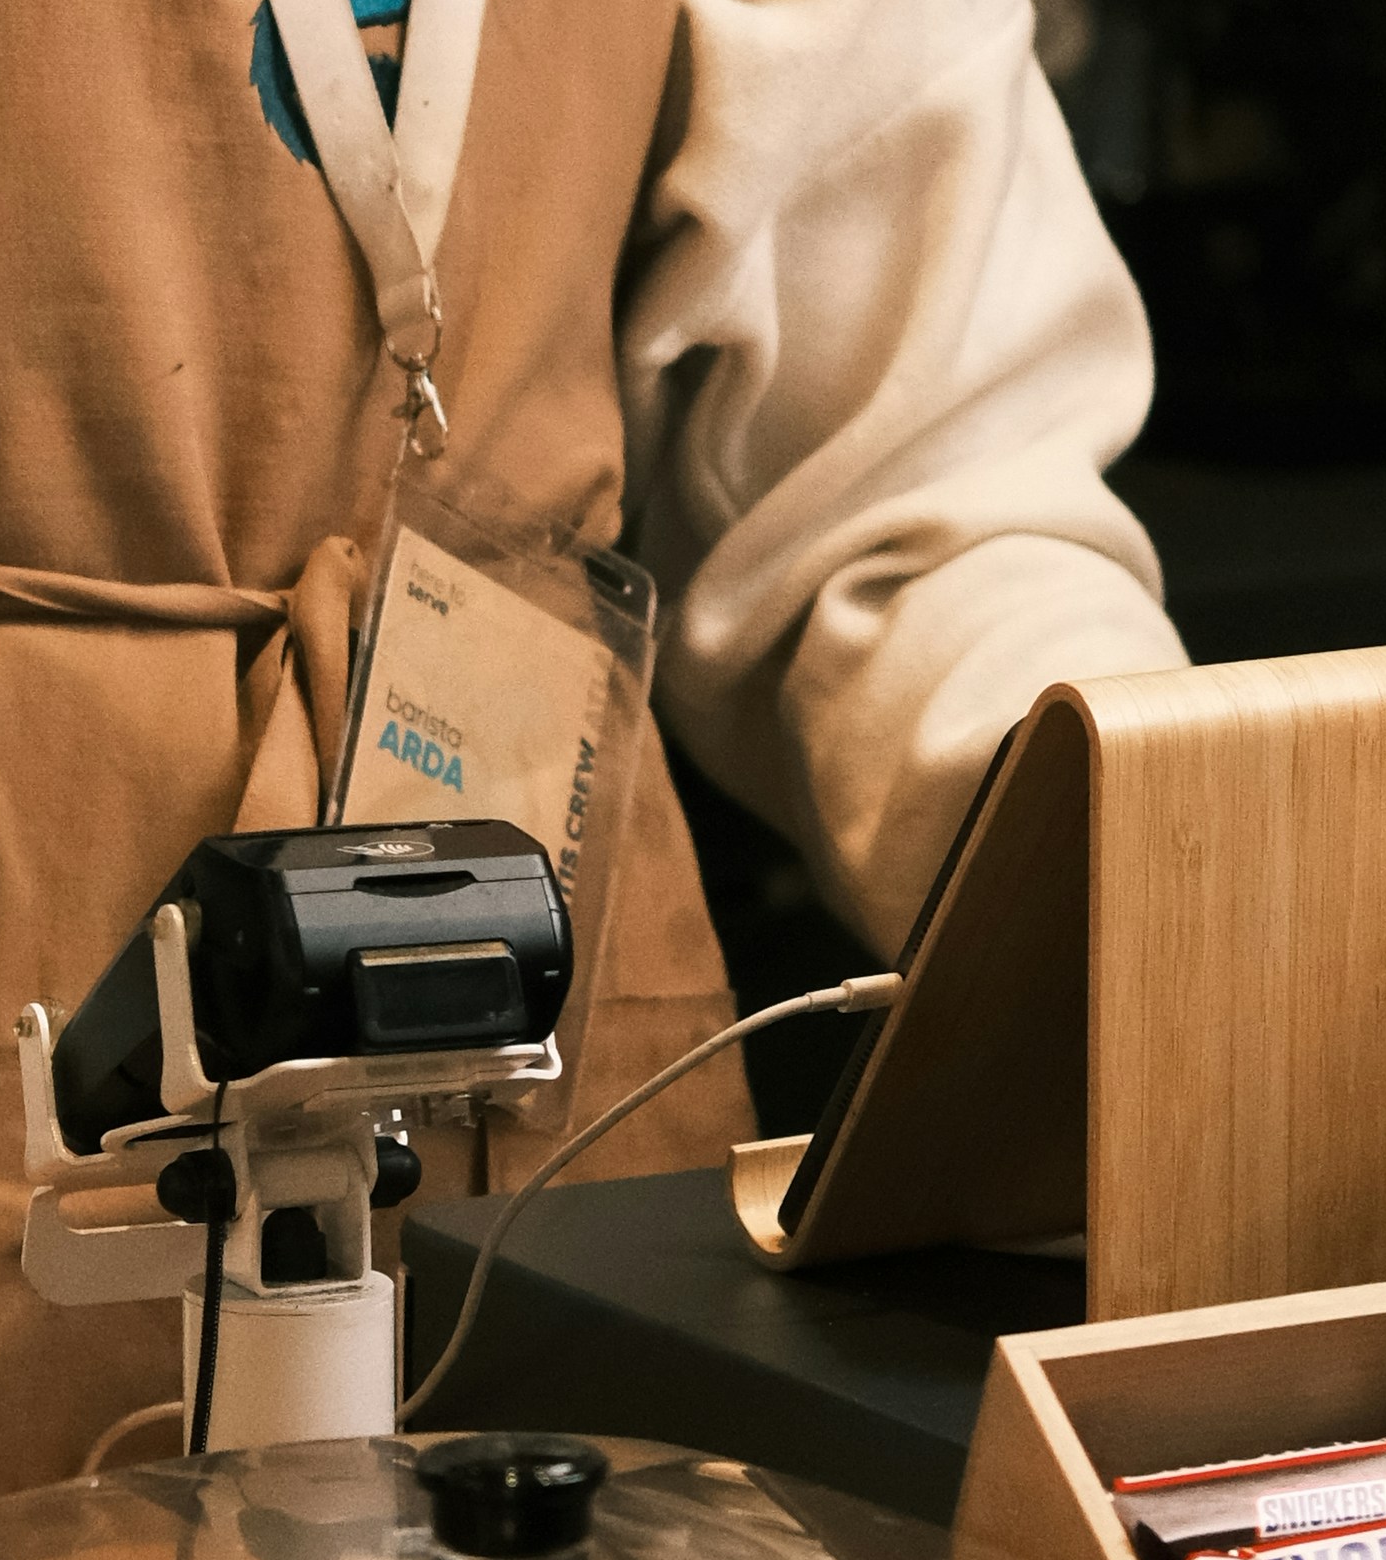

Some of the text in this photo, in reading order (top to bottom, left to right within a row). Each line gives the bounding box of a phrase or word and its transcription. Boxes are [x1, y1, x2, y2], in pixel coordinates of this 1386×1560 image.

[386, 683, 463, 750] barista
[377, 719, 464, 794] ARDA
[566, 735, 596, 842] CREW
